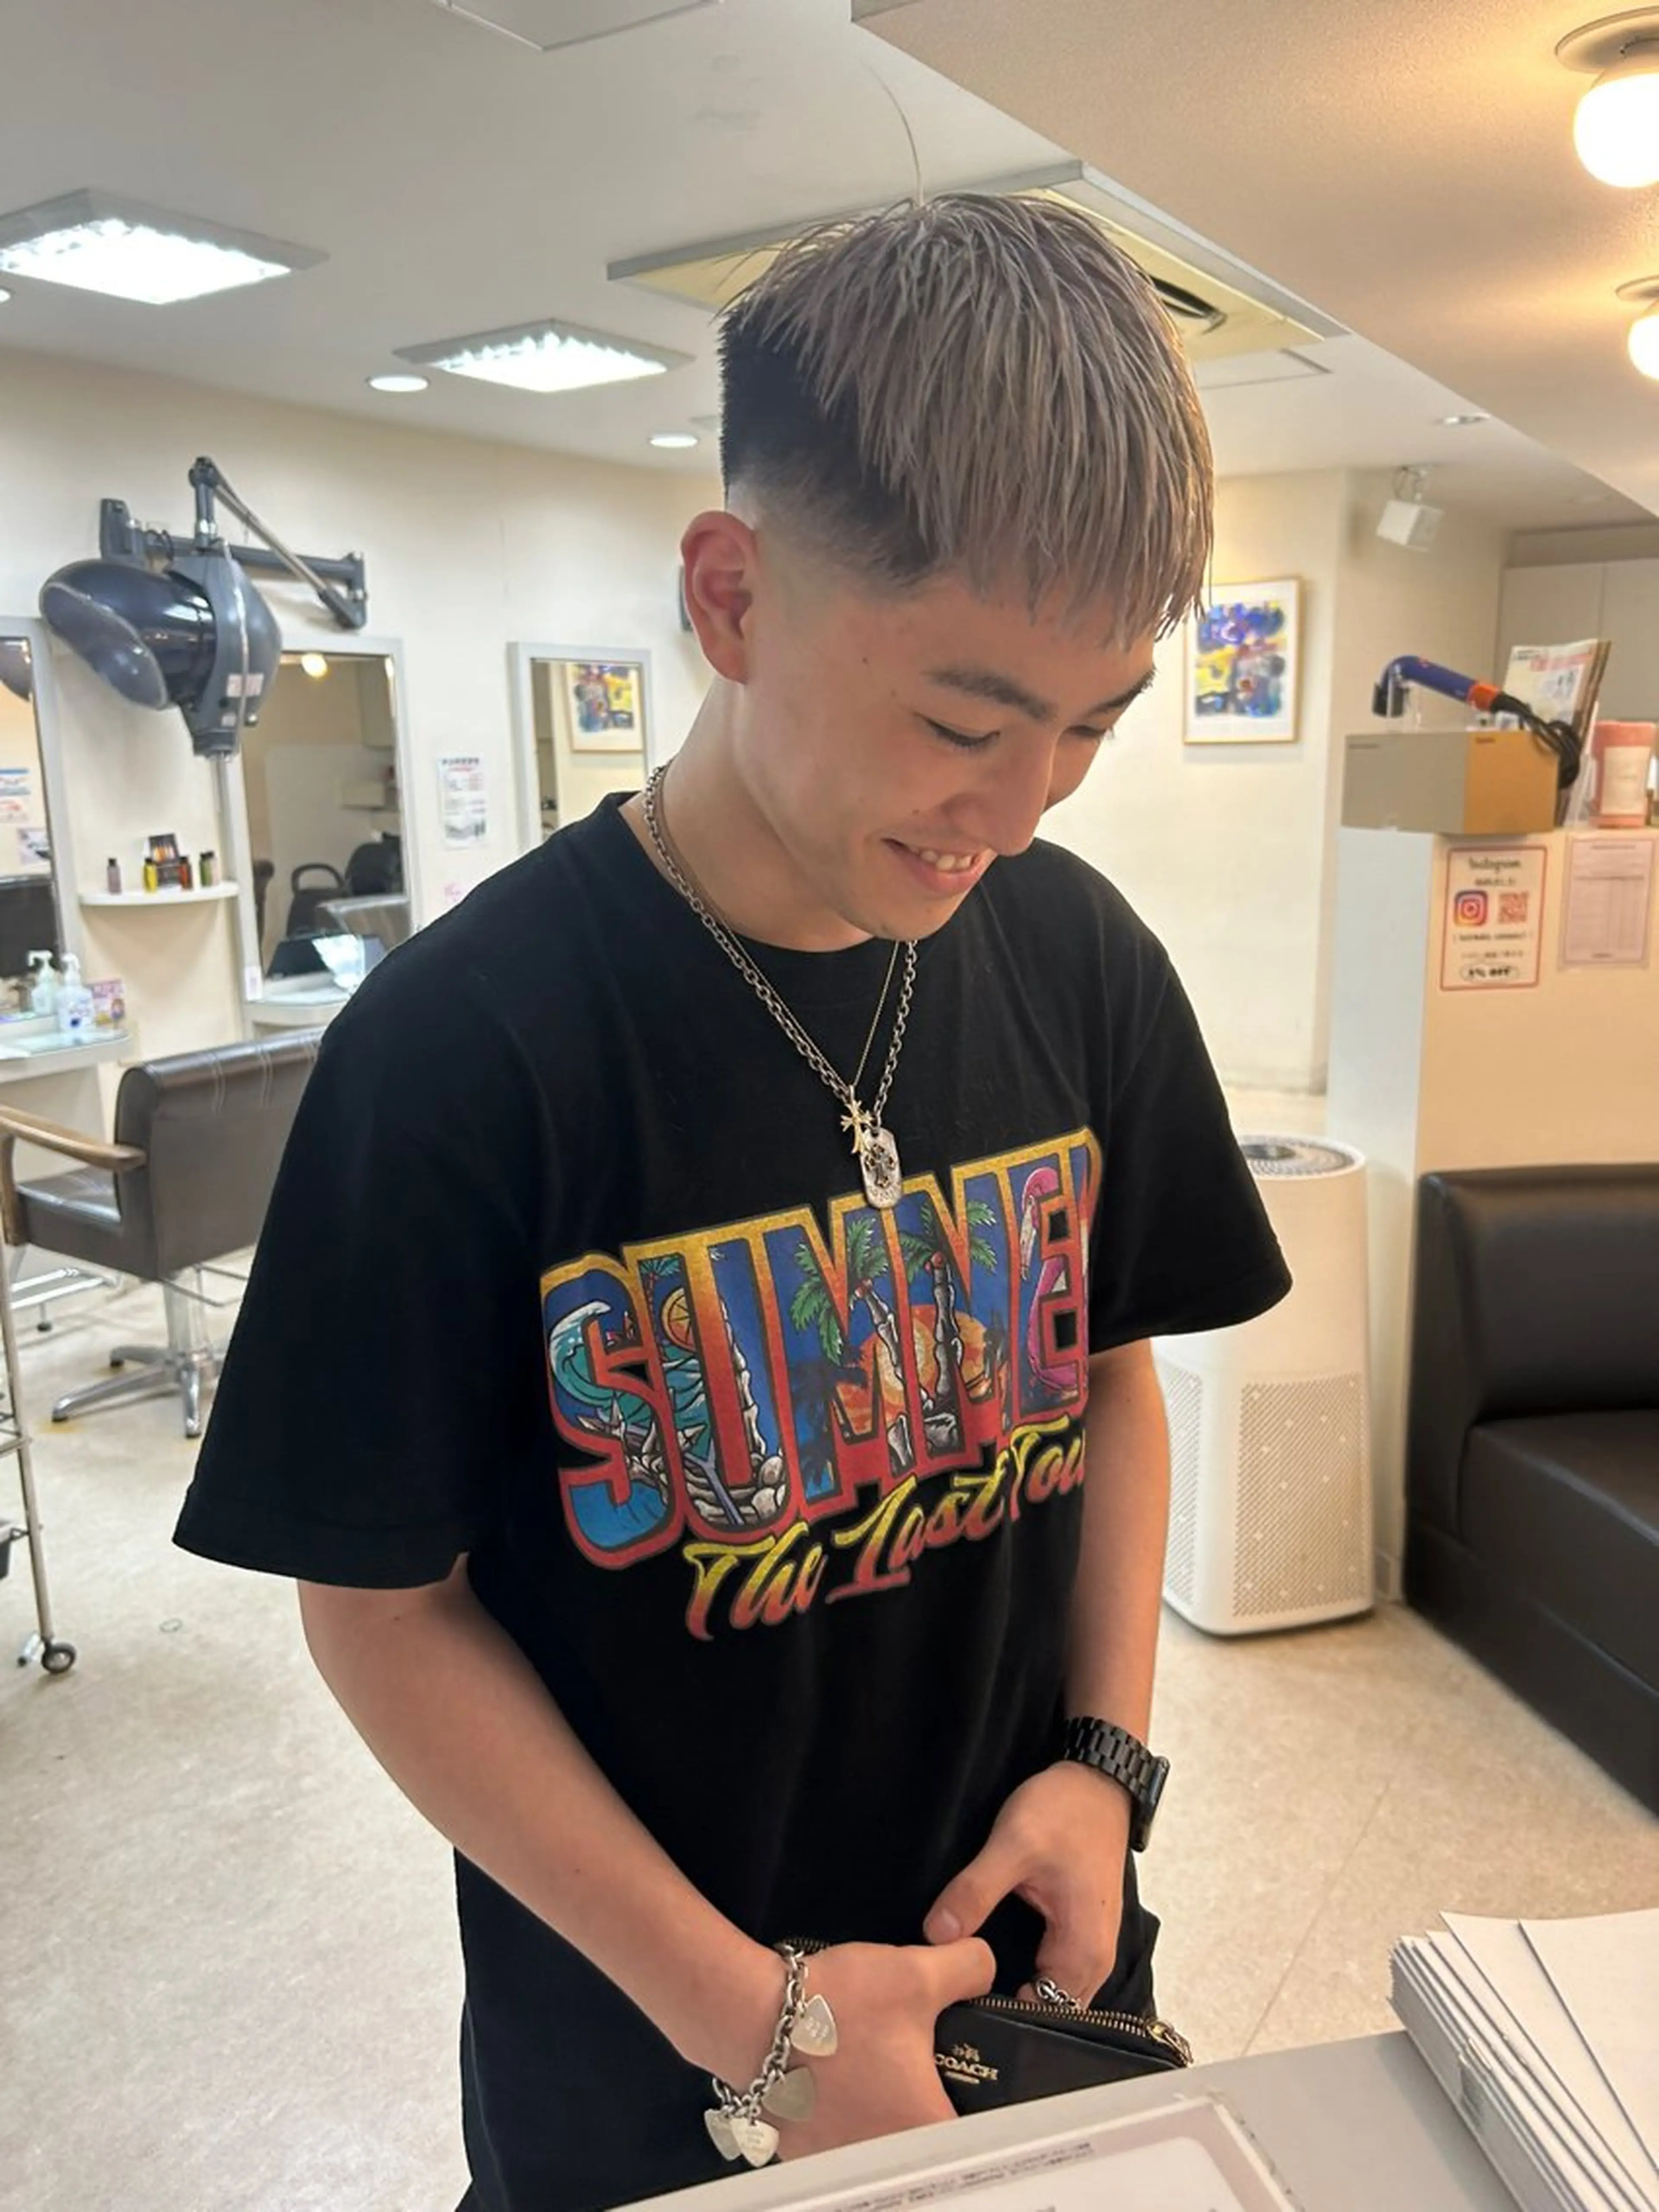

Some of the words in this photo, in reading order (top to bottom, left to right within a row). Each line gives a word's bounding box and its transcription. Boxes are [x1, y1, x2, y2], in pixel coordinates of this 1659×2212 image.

[683, 1521, 828, 1642] The
[825, 1448, 1010, 1605] Last
[934, 2053, 999, 2081] COACH
